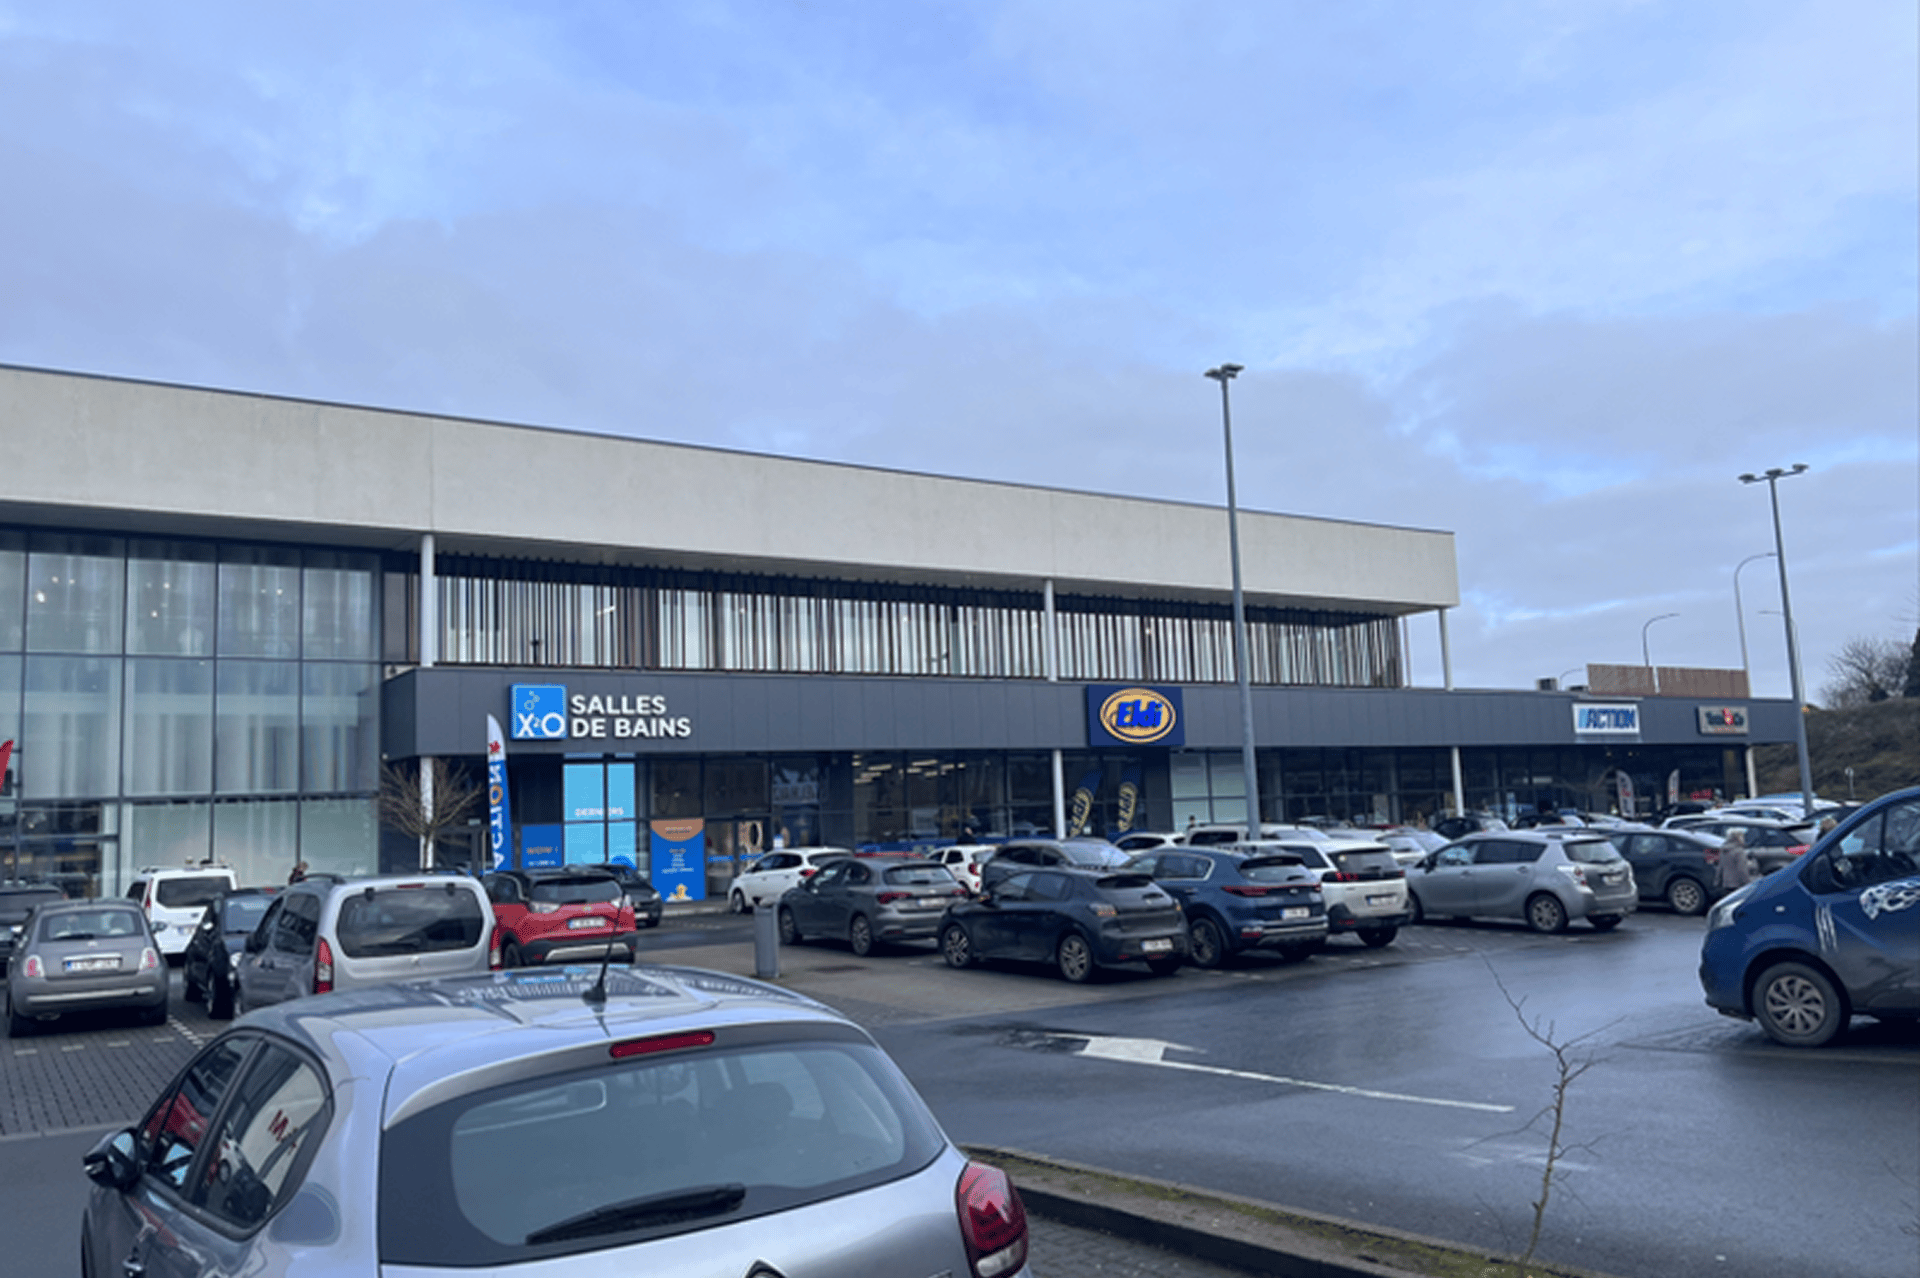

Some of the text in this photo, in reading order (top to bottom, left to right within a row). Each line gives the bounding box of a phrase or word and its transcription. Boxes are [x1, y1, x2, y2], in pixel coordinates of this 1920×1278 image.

[571, 694, 667, 715] SALLES
[572, 716, 692, 738] DE BAINS
[1586, 709, 1636, 728] ACTION
